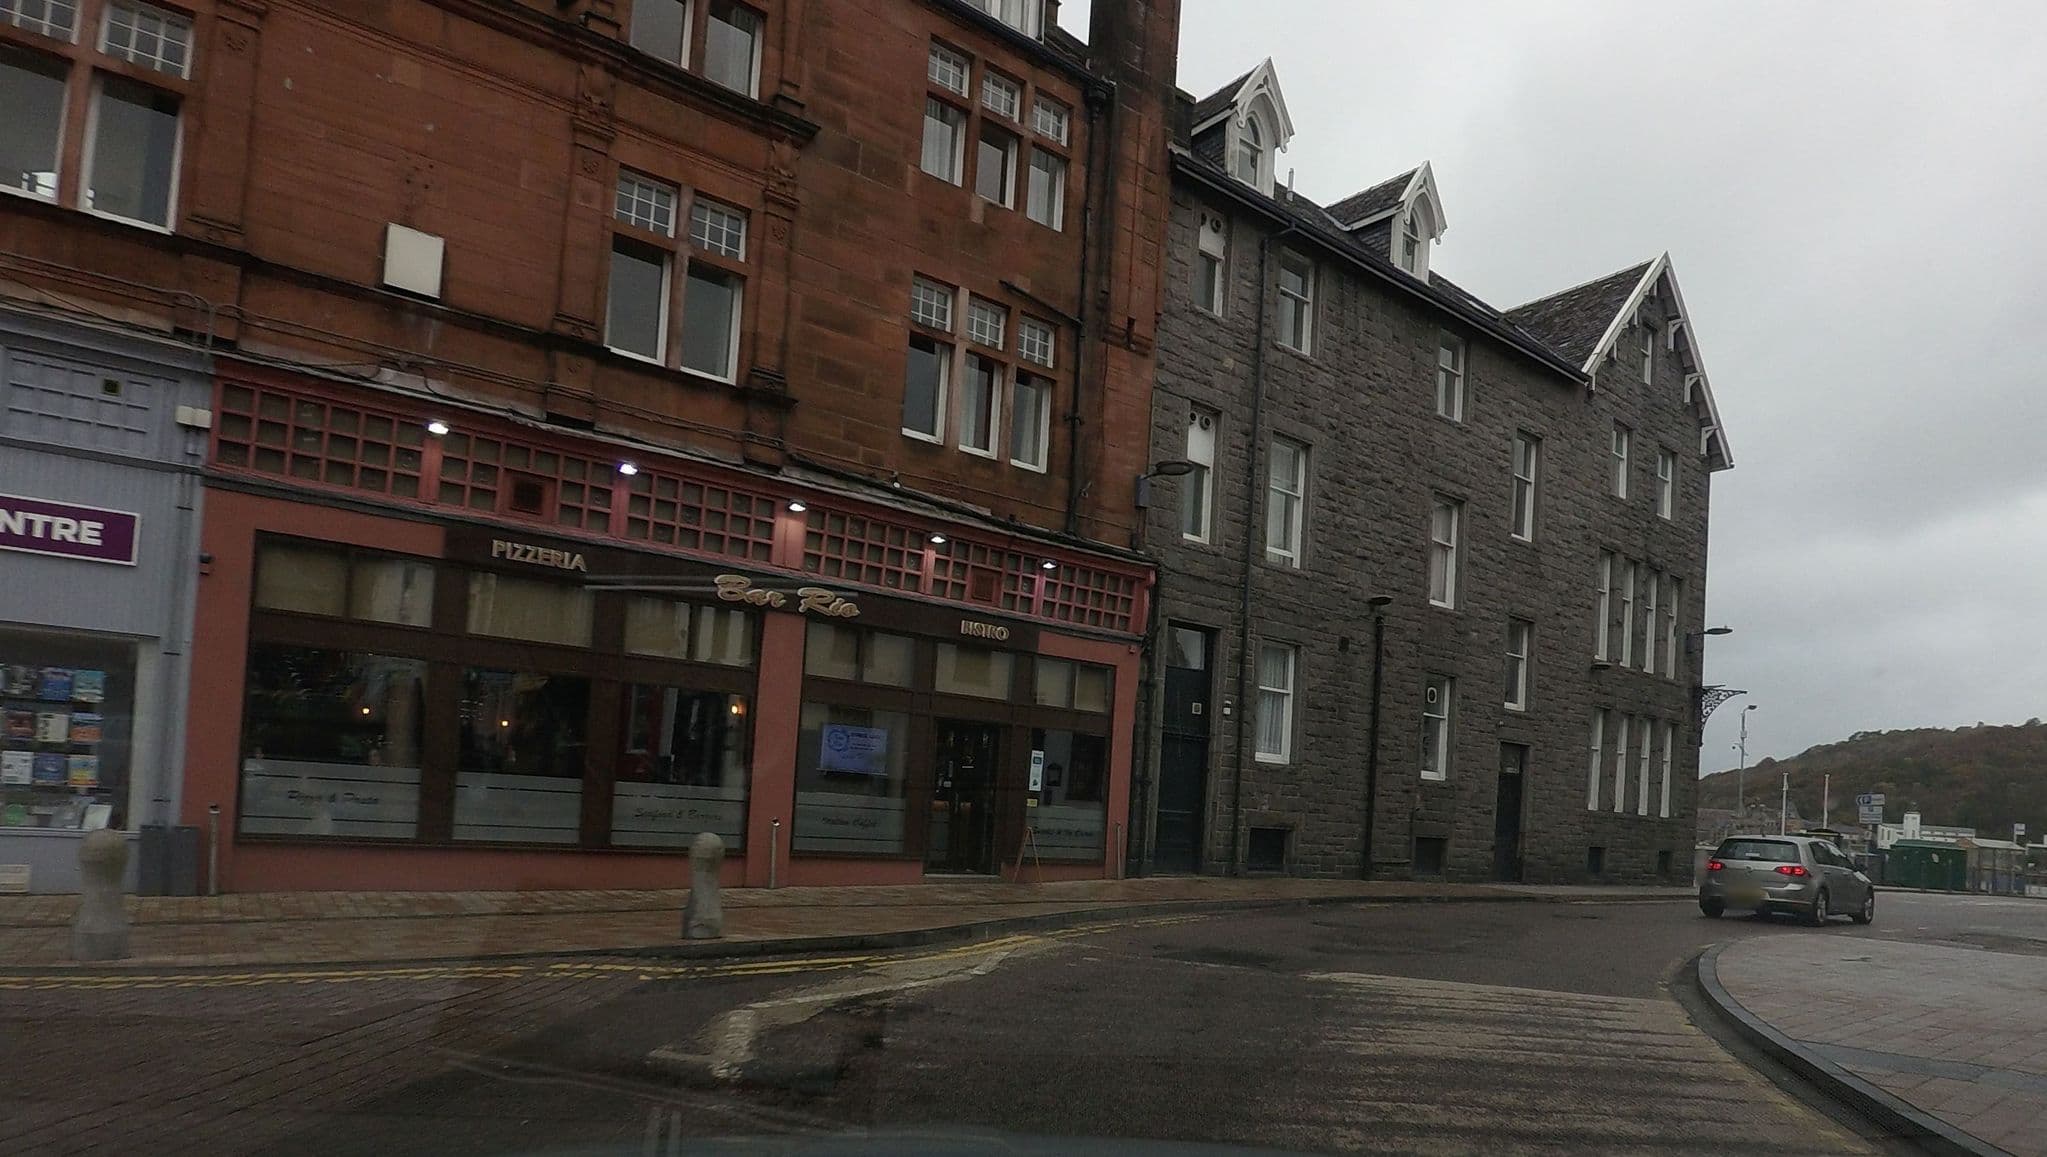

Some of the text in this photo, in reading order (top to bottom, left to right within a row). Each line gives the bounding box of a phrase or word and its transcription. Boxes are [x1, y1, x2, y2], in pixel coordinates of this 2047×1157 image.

[0, 508, 104, 546] NTRE
[491, 539, 587, 572] PIZZERIA
[714, 573, 862, 619] Bar Rio
[960, 620, 1009, 640] BISTRO
